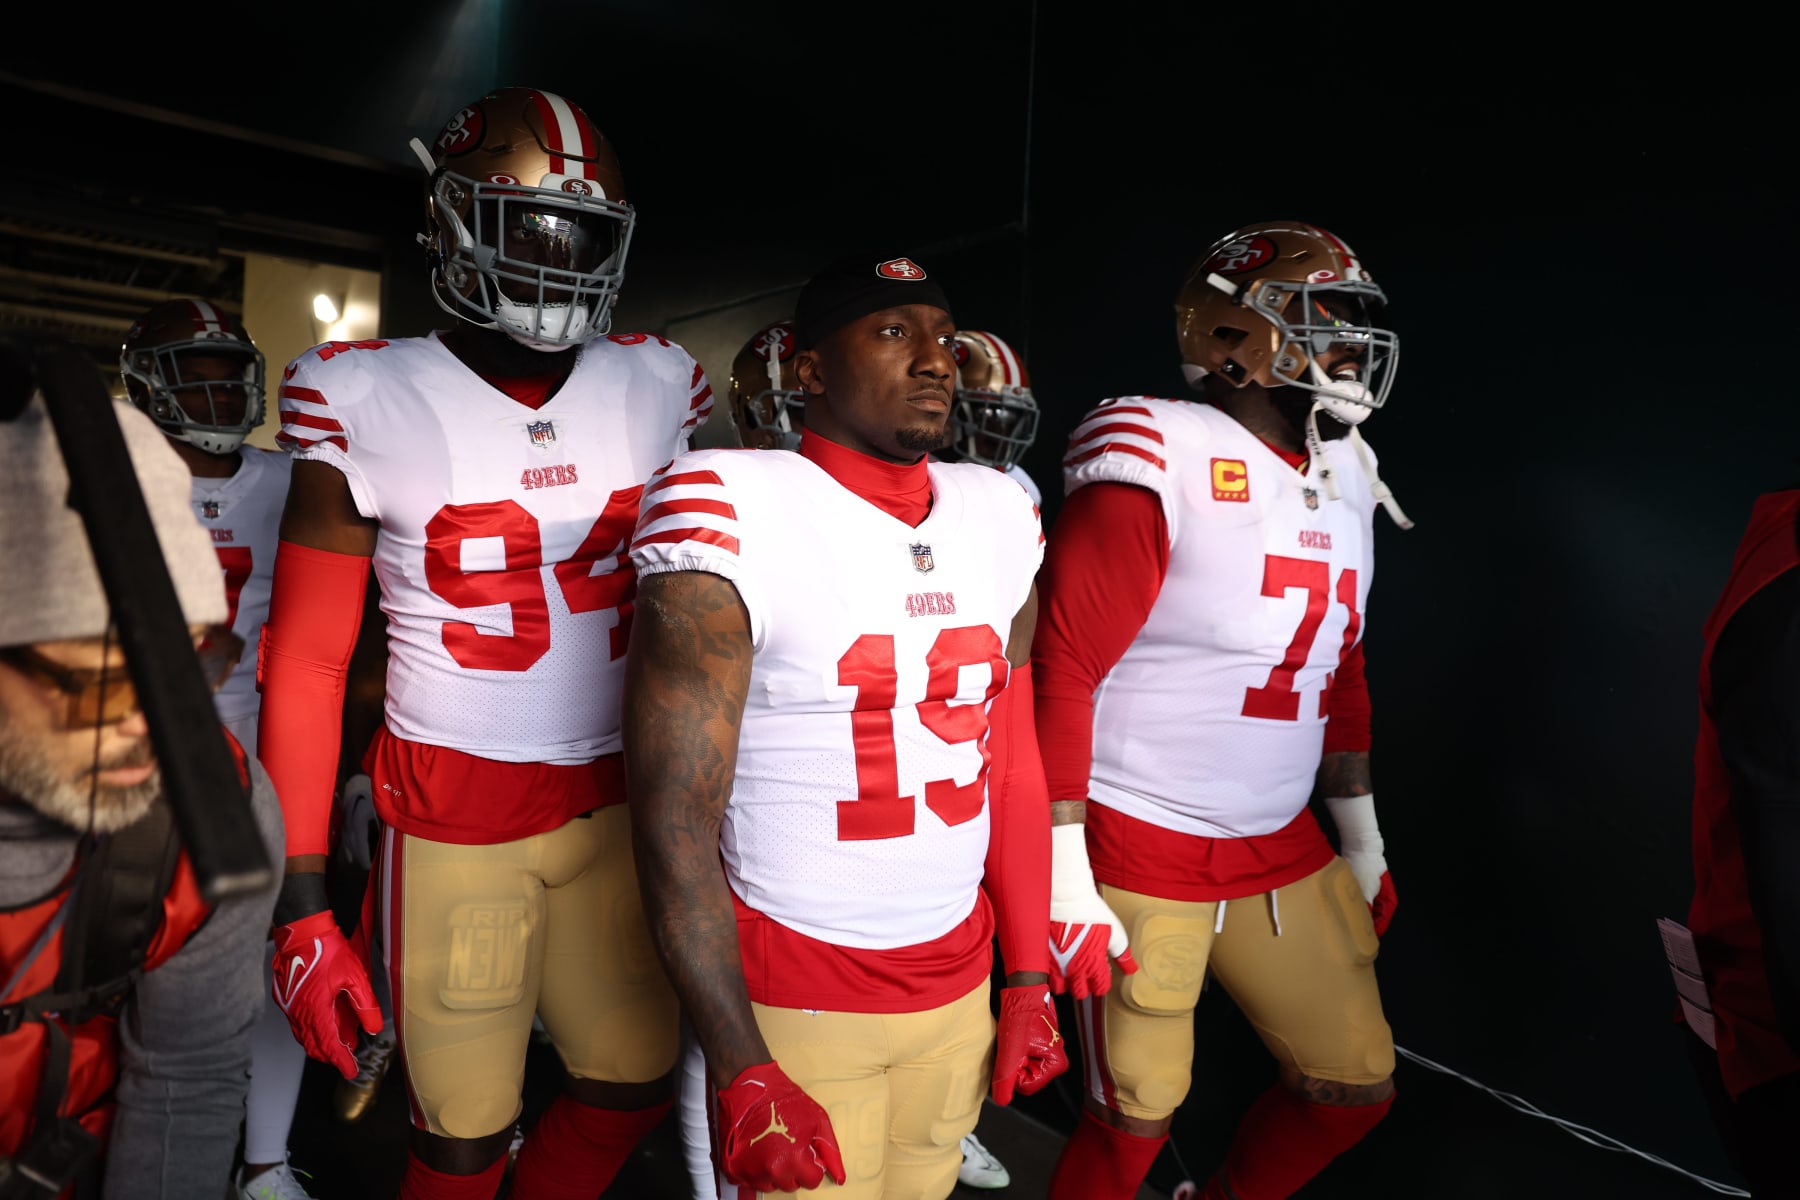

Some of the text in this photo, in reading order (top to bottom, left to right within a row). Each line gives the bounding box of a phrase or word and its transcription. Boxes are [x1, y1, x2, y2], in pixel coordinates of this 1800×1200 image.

[533, 430, 553, 443] NFL
[520, 464, 578, 490] 49ERS
[1213, 461, 1246, 491] C
[914, 555, 933, 569] NFL
[425, 484, 645, 671] 94
[905, 592, 956, 617] 49ERS
[1241, 554, 1361, 721] 71
[837, 623, 1010, 841] 19
